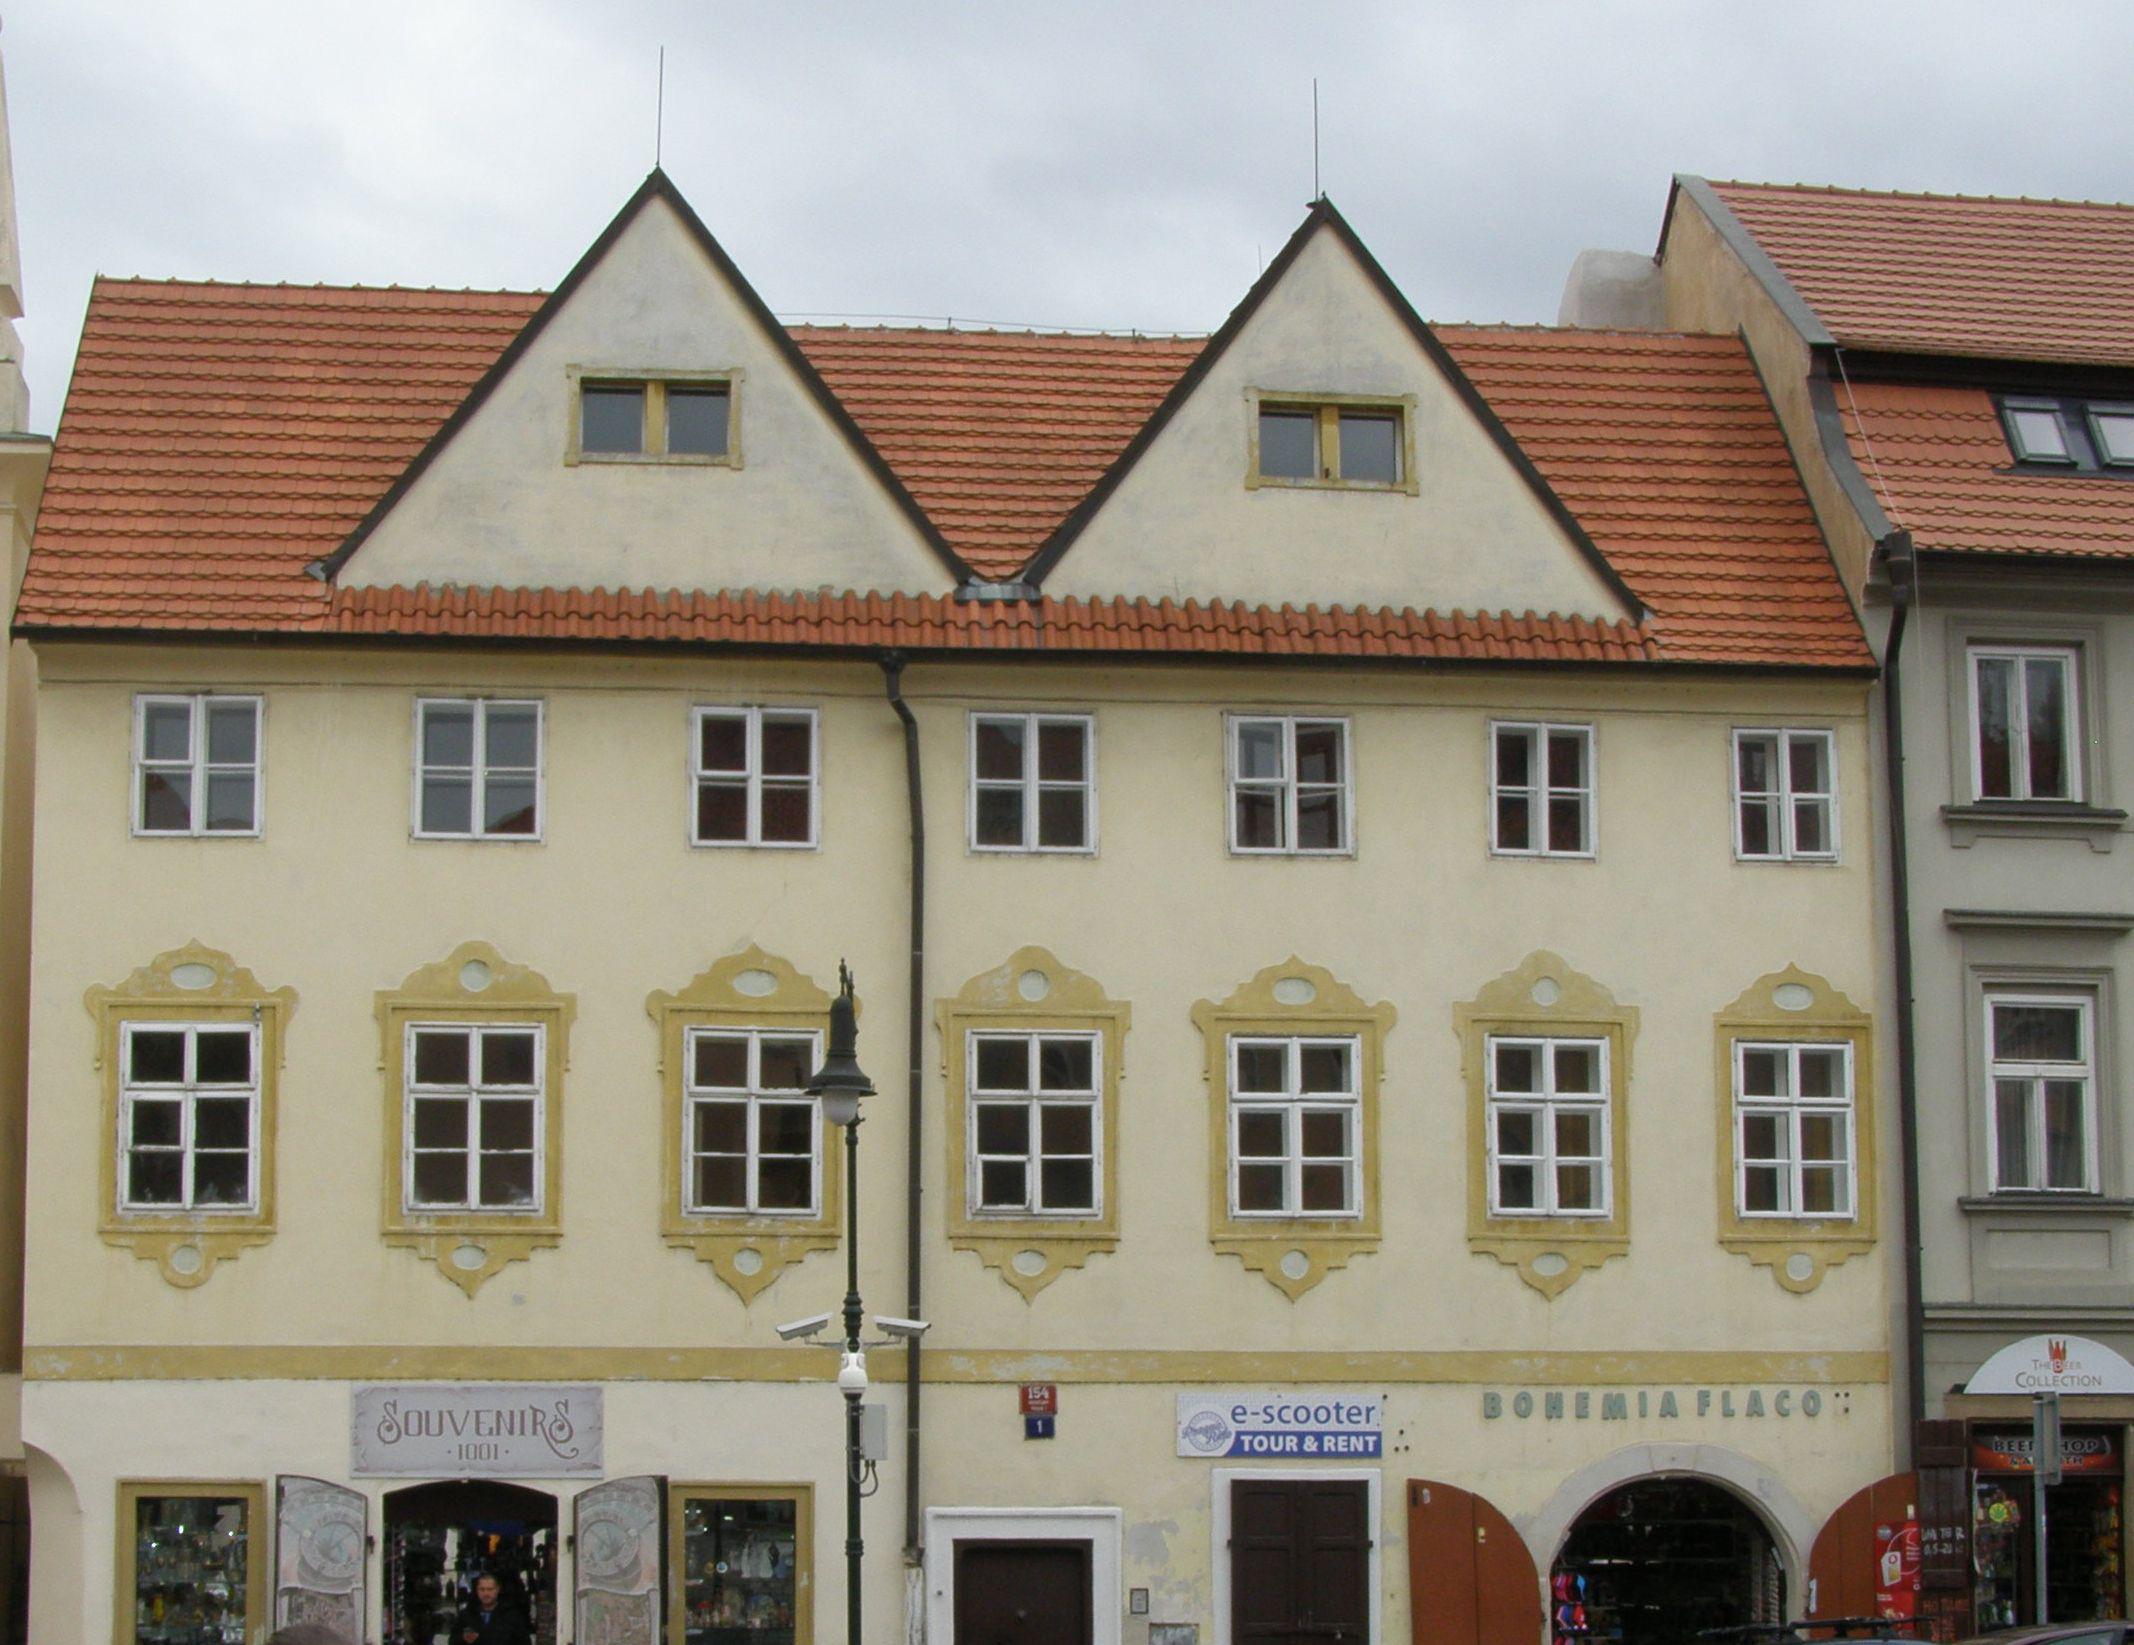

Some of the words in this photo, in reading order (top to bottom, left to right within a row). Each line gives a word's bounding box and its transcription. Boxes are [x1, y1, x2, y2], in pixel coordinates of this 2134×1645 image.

[2015, 1372, 2102, 1388] COLLECTION
[1028, 1386, 1049, 1400] 154
[1231, 1401, 1375, 1424] e-scooter
[1483, 1392, 1679, 1420] BOHEMIA
[1697, 1390, 1823, 1418] FLACO
[377, 1399, 579, 1459] SOUVENIRS
[1036, 1420, 1043, 1434] 1
[1240, 1435, 1299, 1452] TOUR
[1303, 1435, 1319, 1452] &
[1323, 1435, 1378, 1452] RENT
